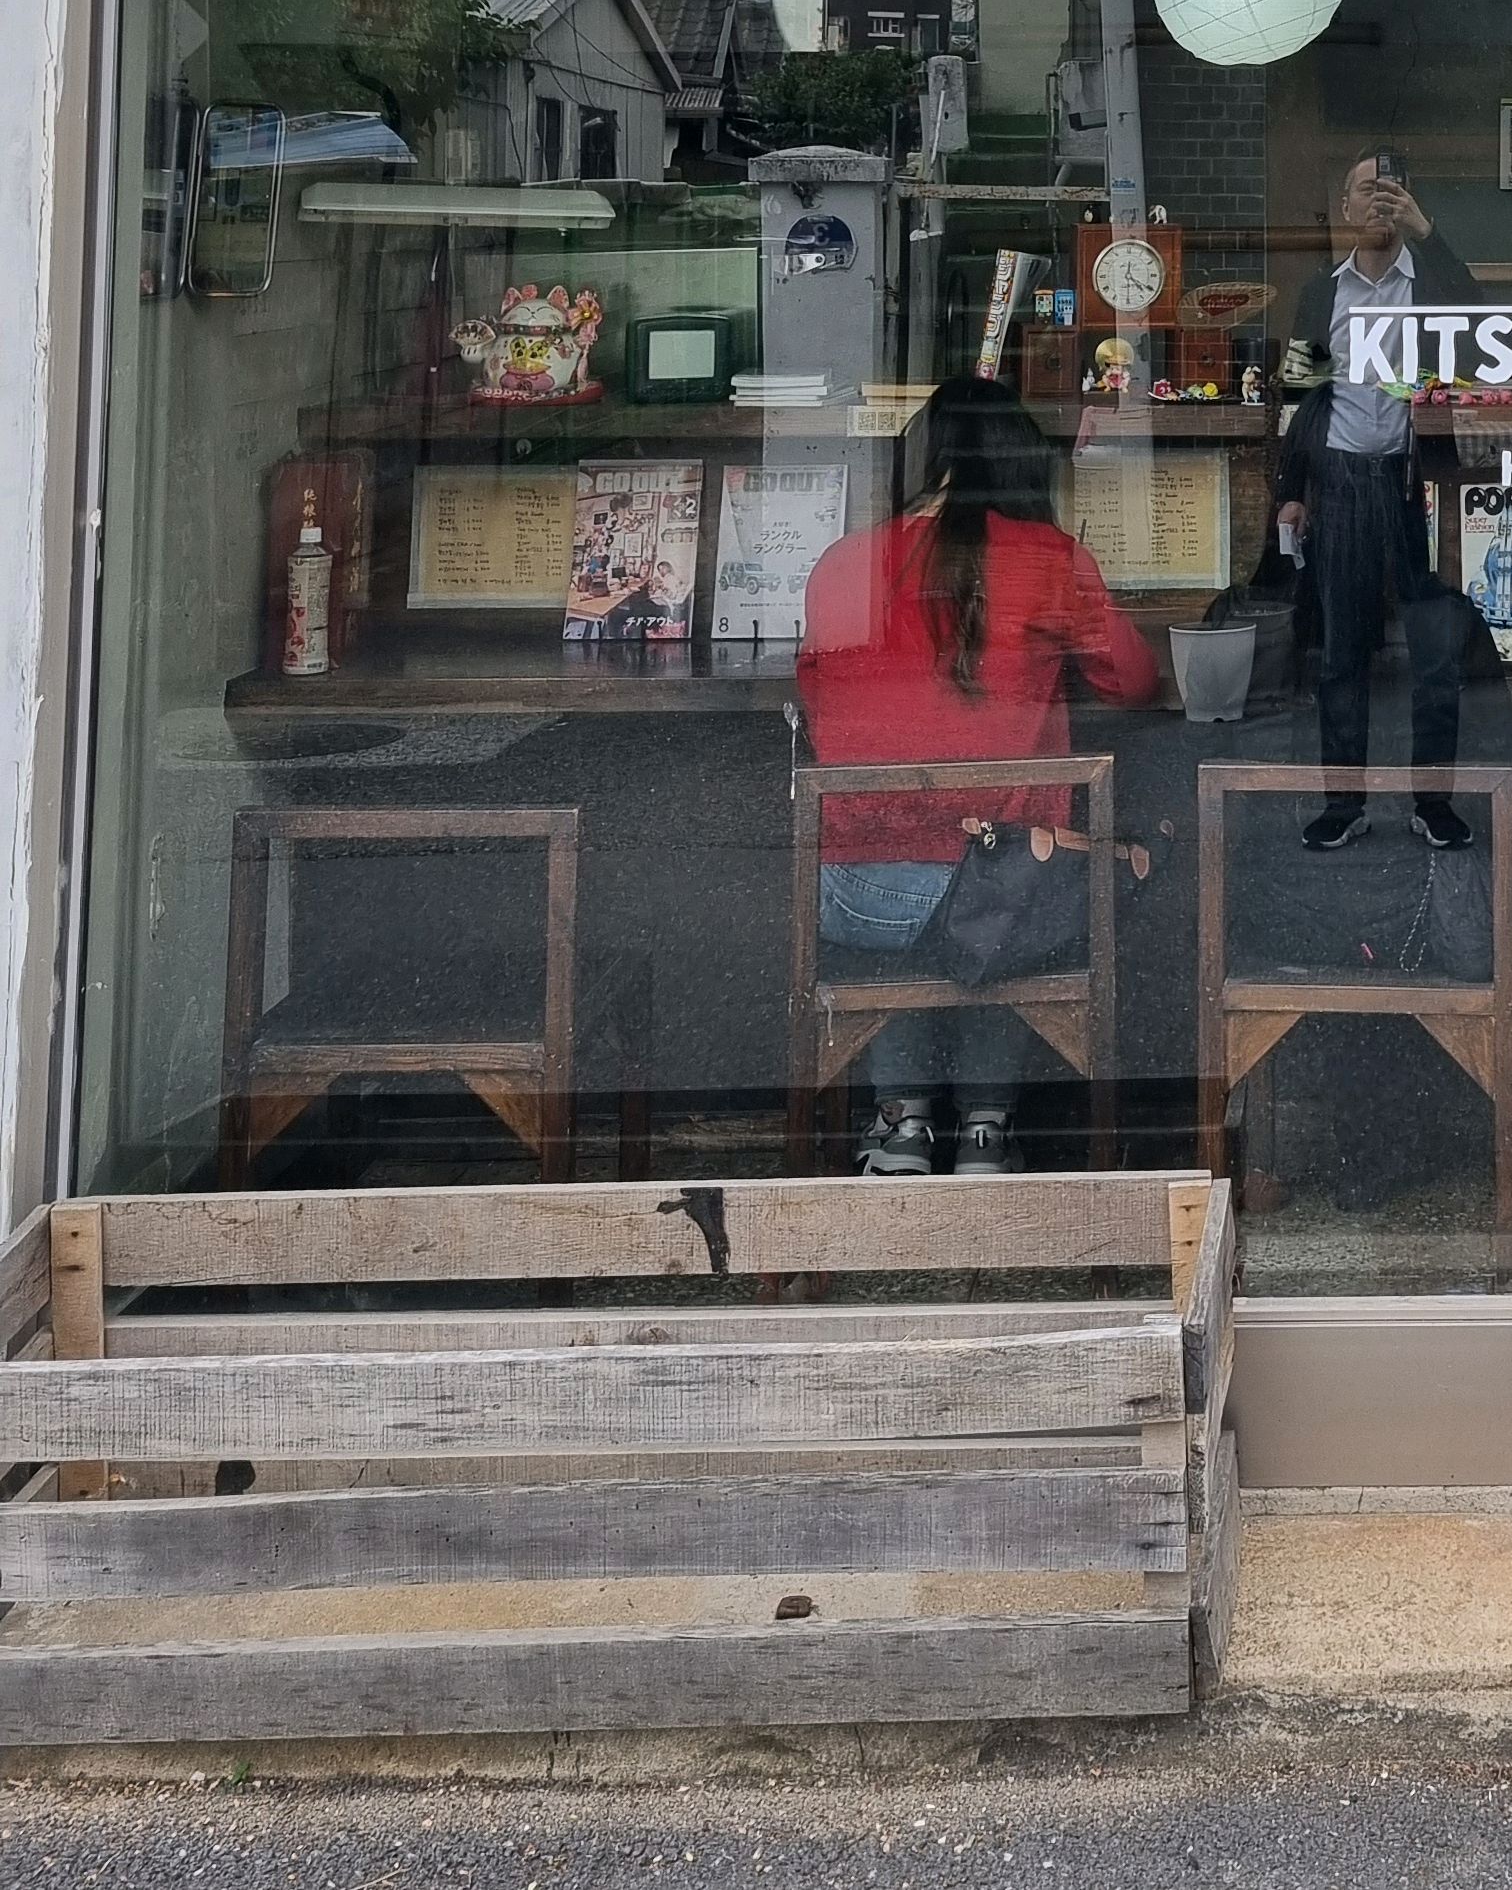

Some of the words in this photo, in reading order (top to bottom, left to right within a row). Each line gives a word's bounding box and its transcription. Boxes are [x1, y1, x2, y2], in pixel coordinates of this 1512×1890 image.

[595, 471, 631, 493] GO
[744, 472, 778, 493] GO
[780, 472, 828, 493] OUT
[760, 529, 802, 541] ランクル
[752, 543, 808, 555] ラングラー
[718, 616, 730, 633] 8
